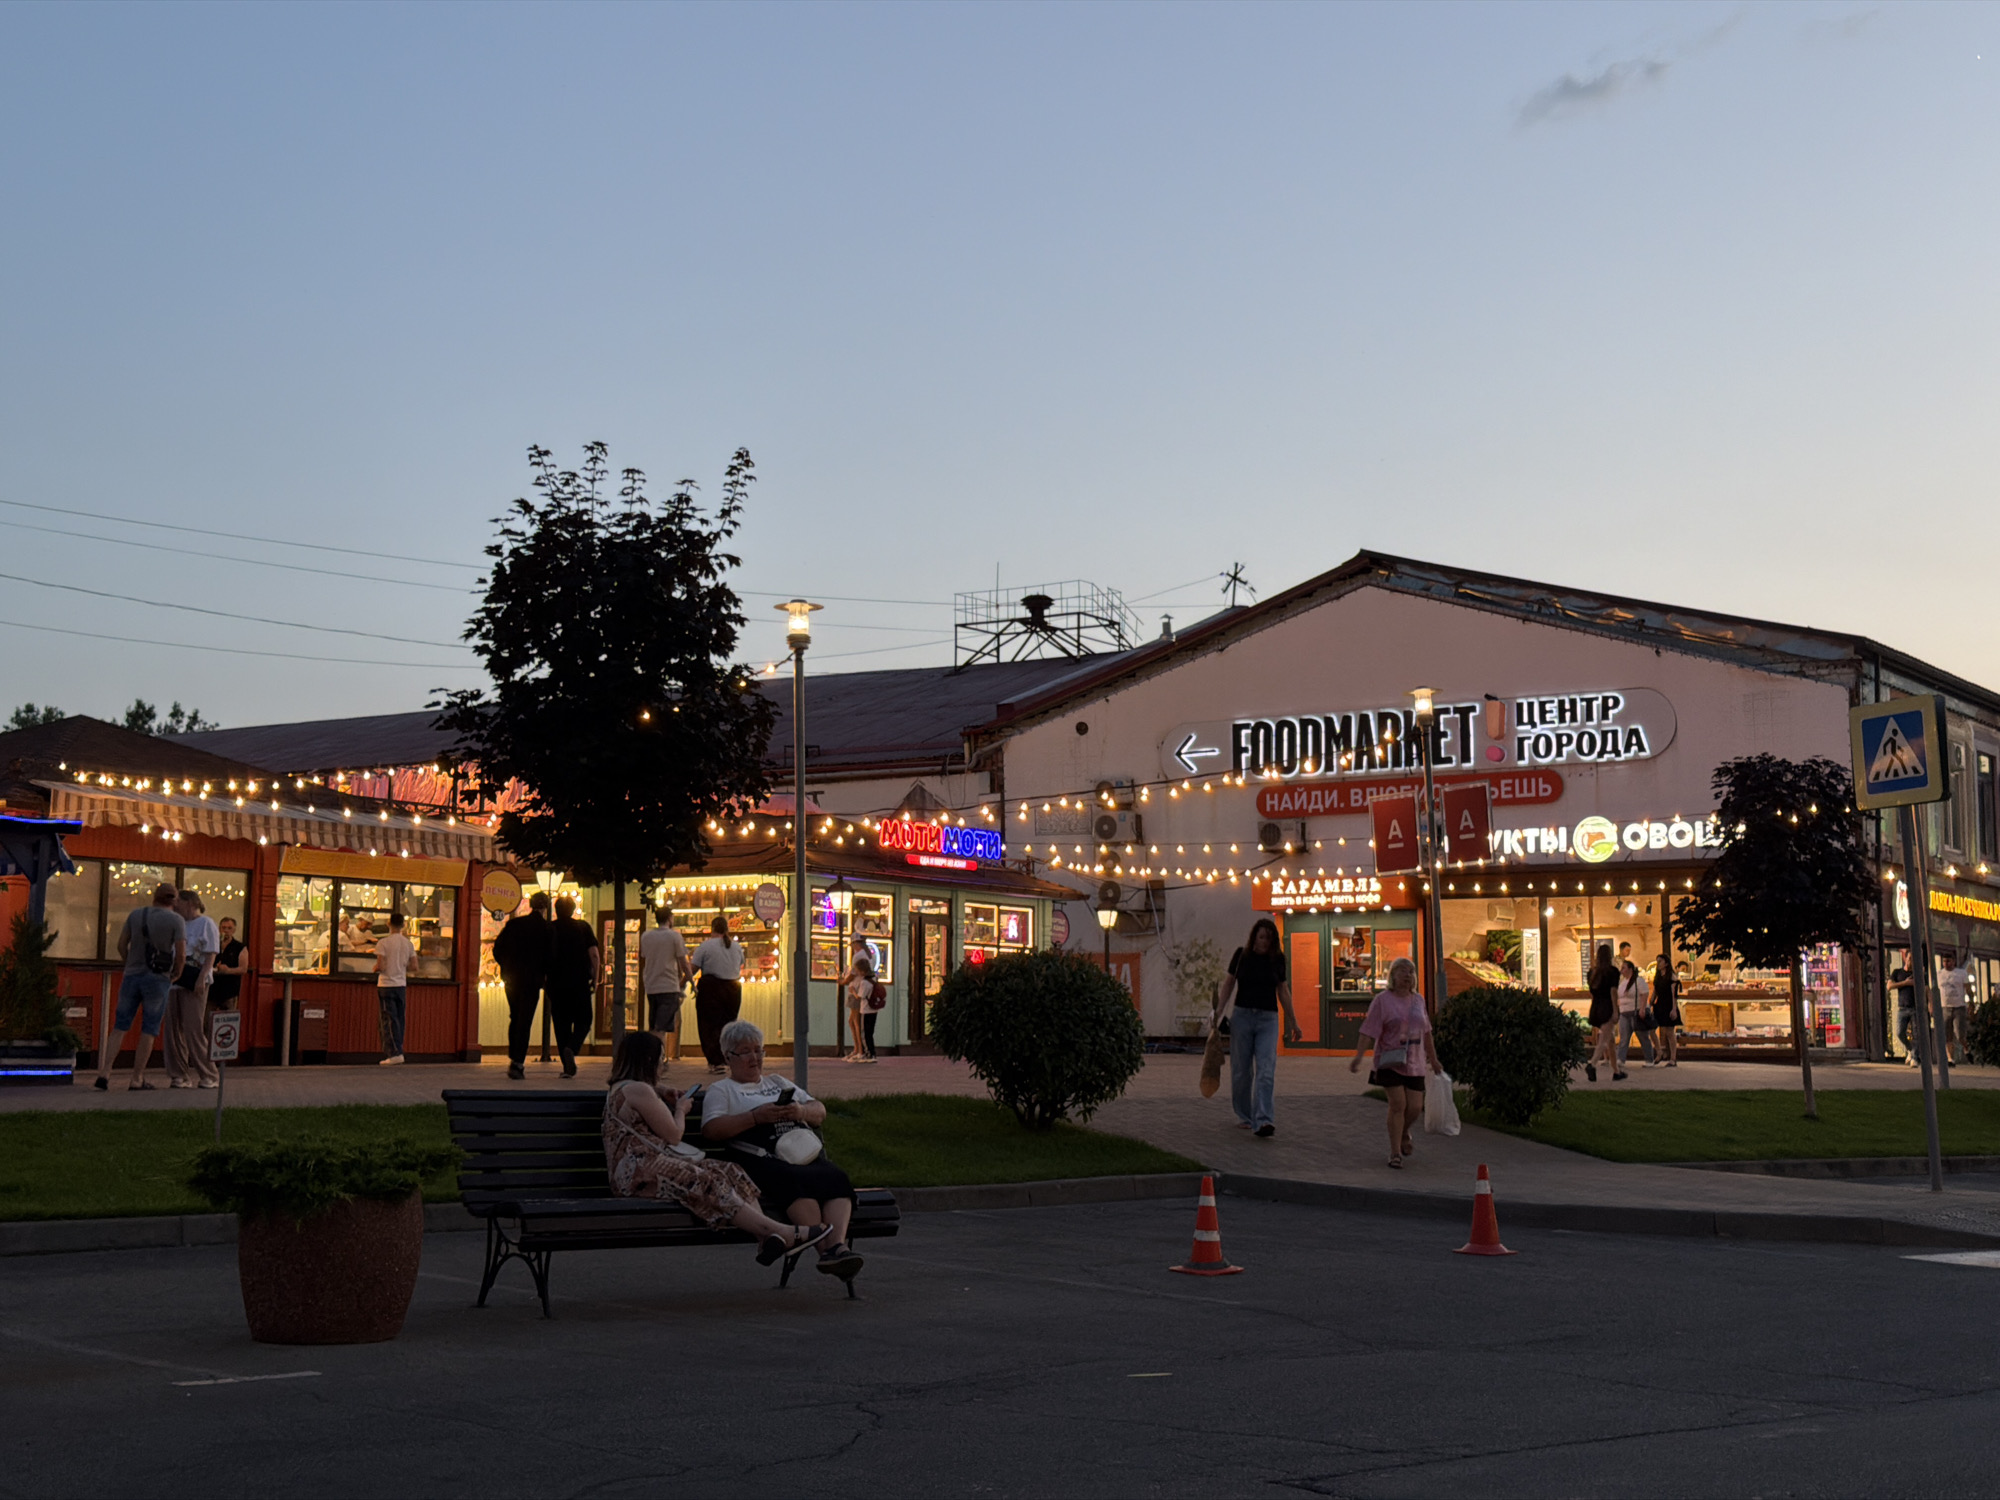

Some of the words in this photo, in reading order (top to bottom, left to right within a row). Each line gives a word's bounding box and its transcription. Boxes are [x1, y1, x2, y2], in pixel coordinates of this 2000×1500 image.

[1516, 693, 1624, 730] ЦЕНТР
[1516, 726, 1649, 764] ГОРОДА
[1265, 786, 1345, 813] НАЙДИ.
[1271, 877, 1382, 895] КАРАМЕЛЬ
[1355, 893, 1381, 905] кофе
